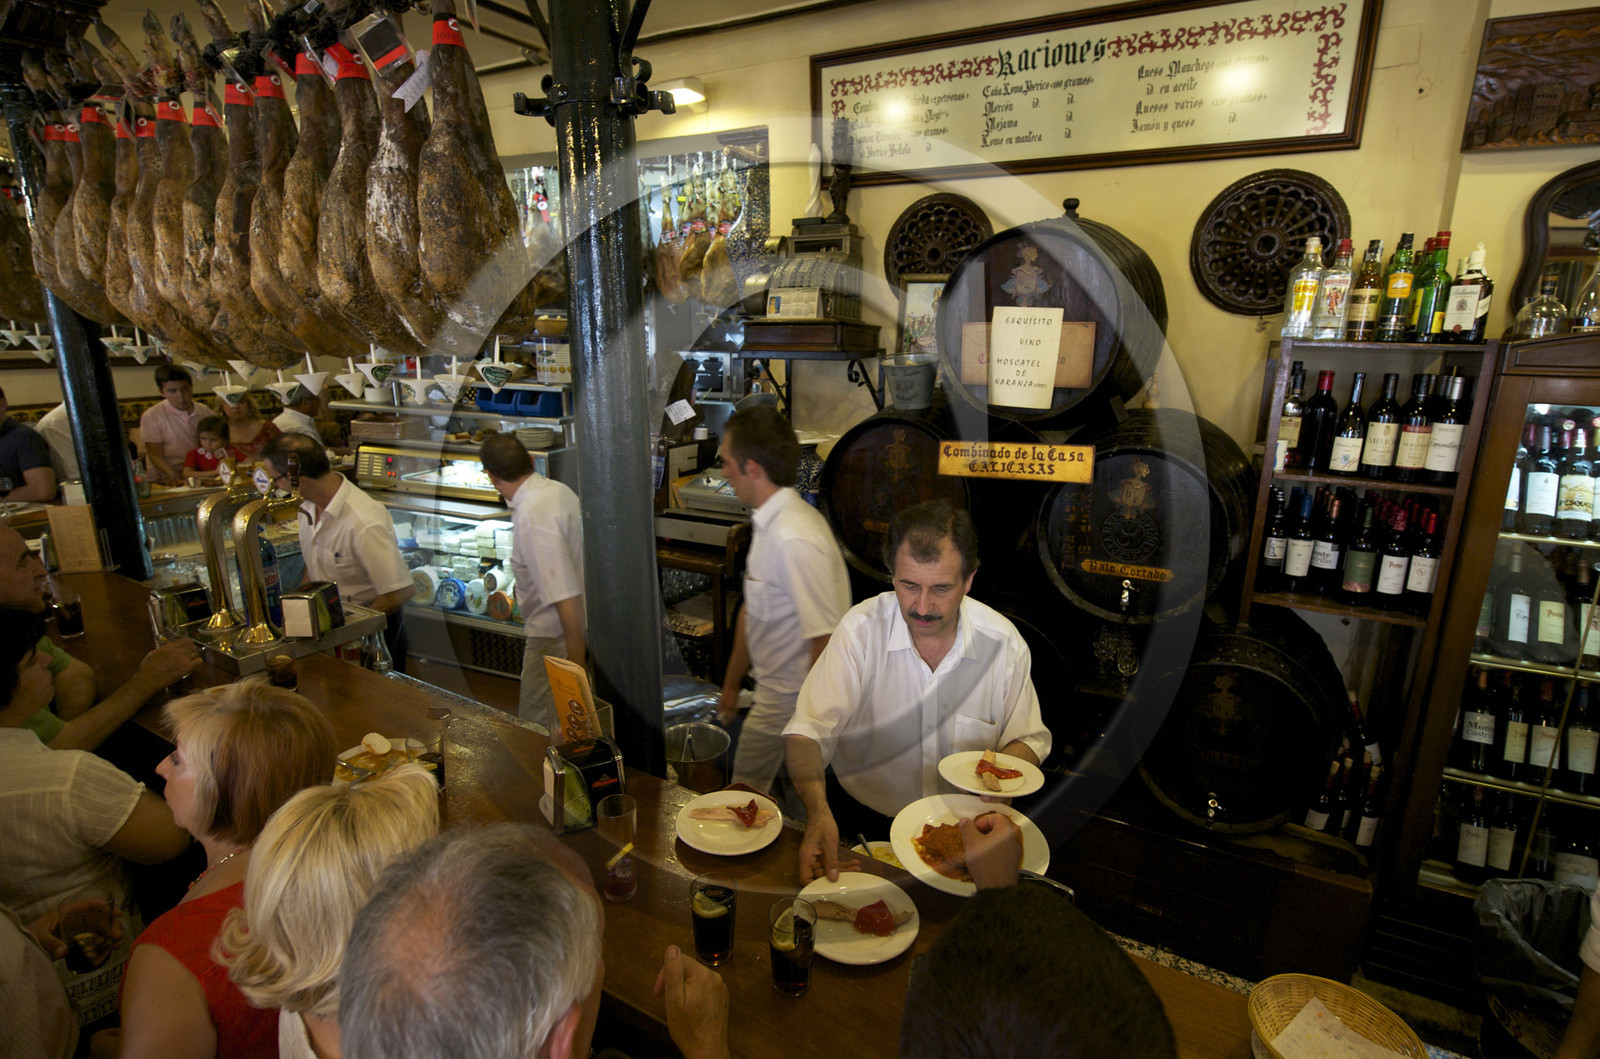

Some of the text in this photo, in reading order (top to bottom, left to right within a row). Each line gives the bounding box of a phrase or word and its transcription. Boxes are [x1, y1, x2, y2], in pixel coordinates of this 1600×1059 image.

[996, 38, 1107, 80] Raciones
[1137, 65, 1163, 81] Queso
[1166, 58, 1215, 80] Manchego
[1160, 84, 1169, 95] en
[1173, 77, 1197, 92] aceite
[1136, 101, 1168, 116] Quesos
[1175, 97, 1203, 111] varios
[982, 117, 1018, 132] Mojama
[1163, 121, 1168, 131] y
[1172, 118, 1195, 133] queso
[1005, 137, 1013, 145] en
[1015, 131, 1042, 144] manteca
[1005, 316, 1053, 326] EXQUISITO
[1019, 338, 1042, 347] VINO
[996, 358, 1041, 368] MOSCATEL
[1016, 369, 1027, 377] DE
[994, 378, 1033, 388] NARANJA
[943, 442, 1086, 462] Combinado de la Casa
[968, 460, 1056, 476] CALICASAS
